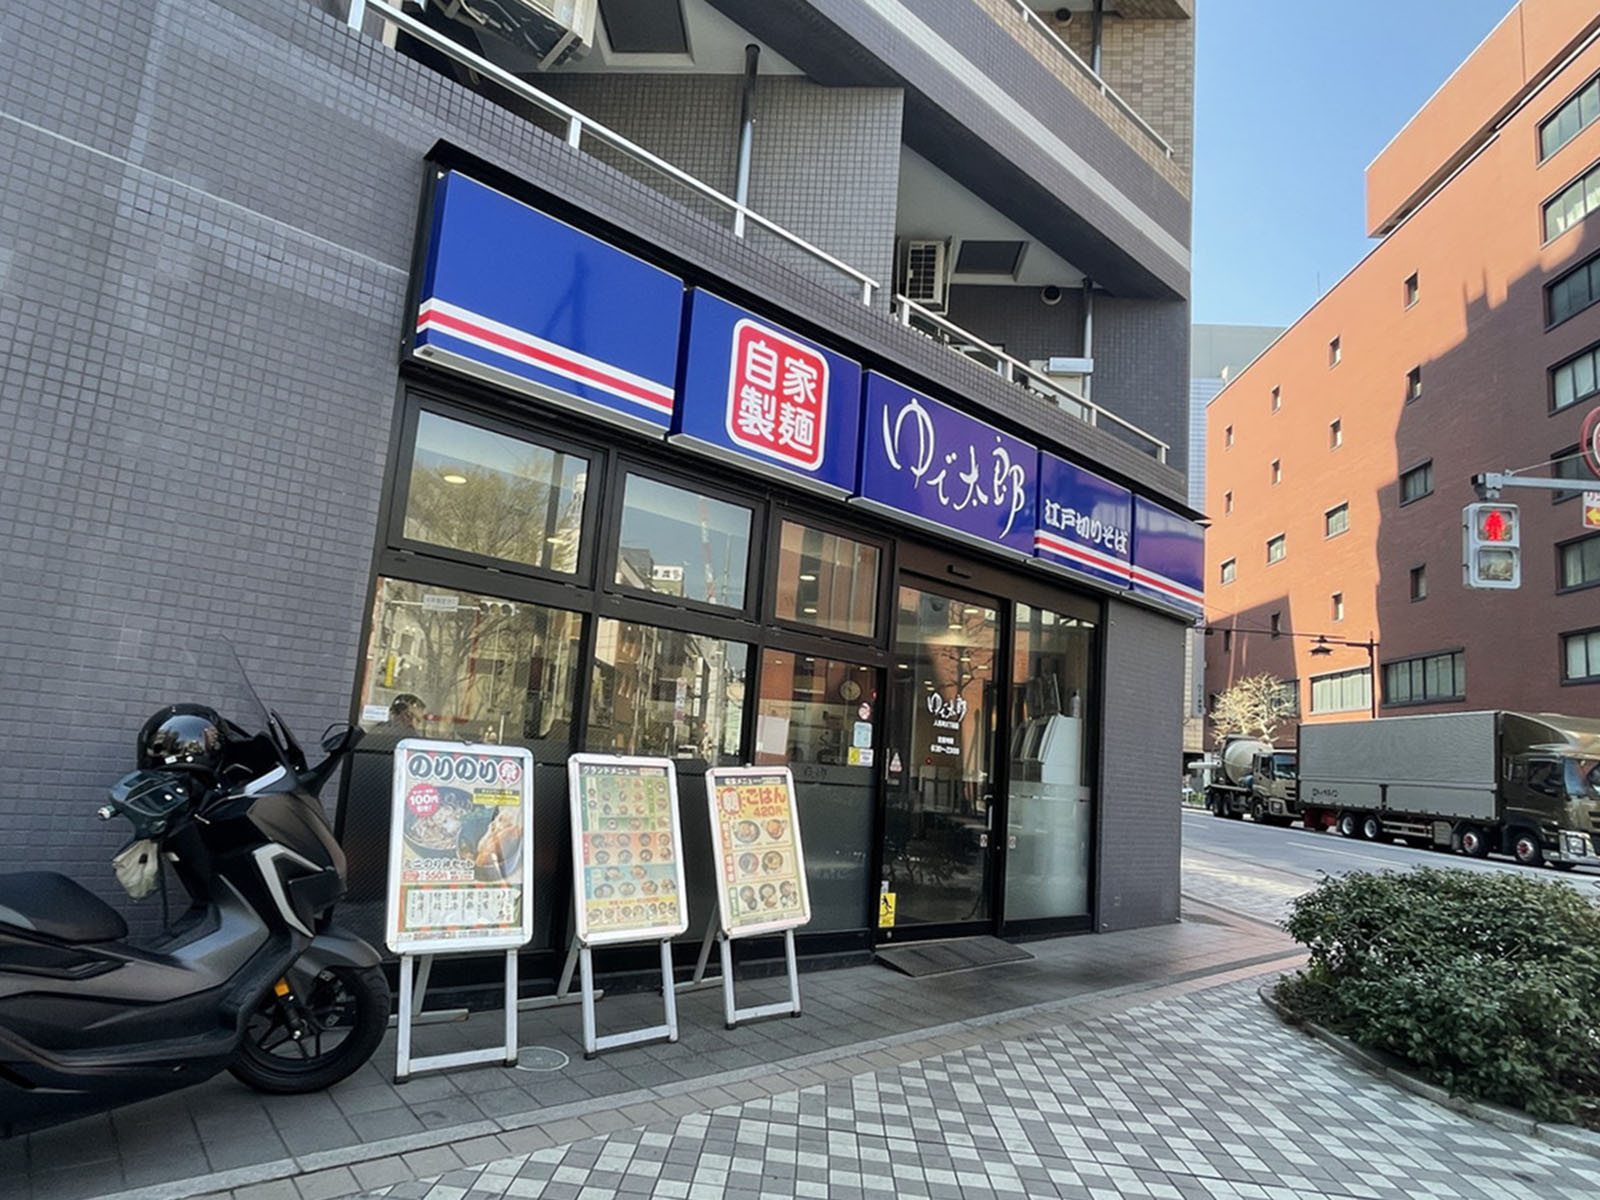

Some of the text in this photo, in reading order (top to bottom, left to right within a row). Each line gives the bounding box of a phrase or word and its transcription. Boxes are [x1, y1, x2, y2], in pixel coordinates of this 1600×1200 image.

[745, 340, 818, 404] 自家
[737, 384, 815, 455] 製麺
[882, 398, 1027, 539] ゆで太郎
[1044, 499, 1128, 555] 江戸切りそば
